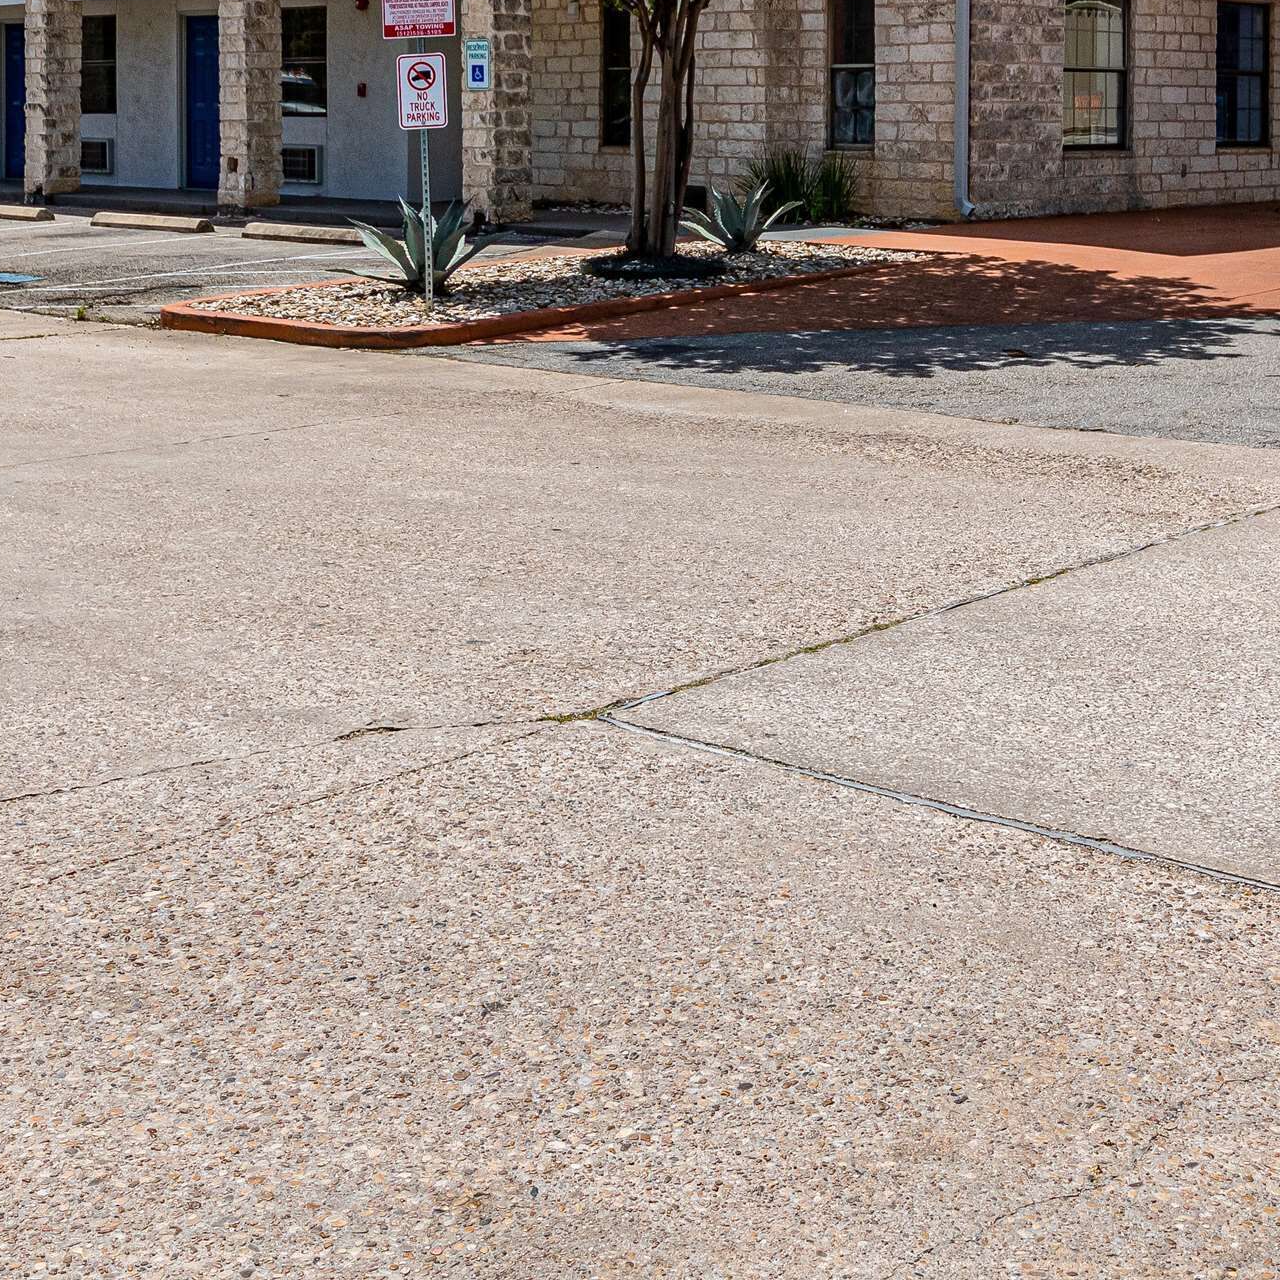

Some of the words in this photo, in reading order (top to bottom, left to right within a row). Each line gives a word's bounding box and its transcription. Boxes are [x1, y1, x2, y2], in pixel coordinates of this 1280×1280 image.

[417, 92, 428, 101] NO
[410, 102, 436, 112] TRUCK
[407, 112, 440, 122] PARKING
